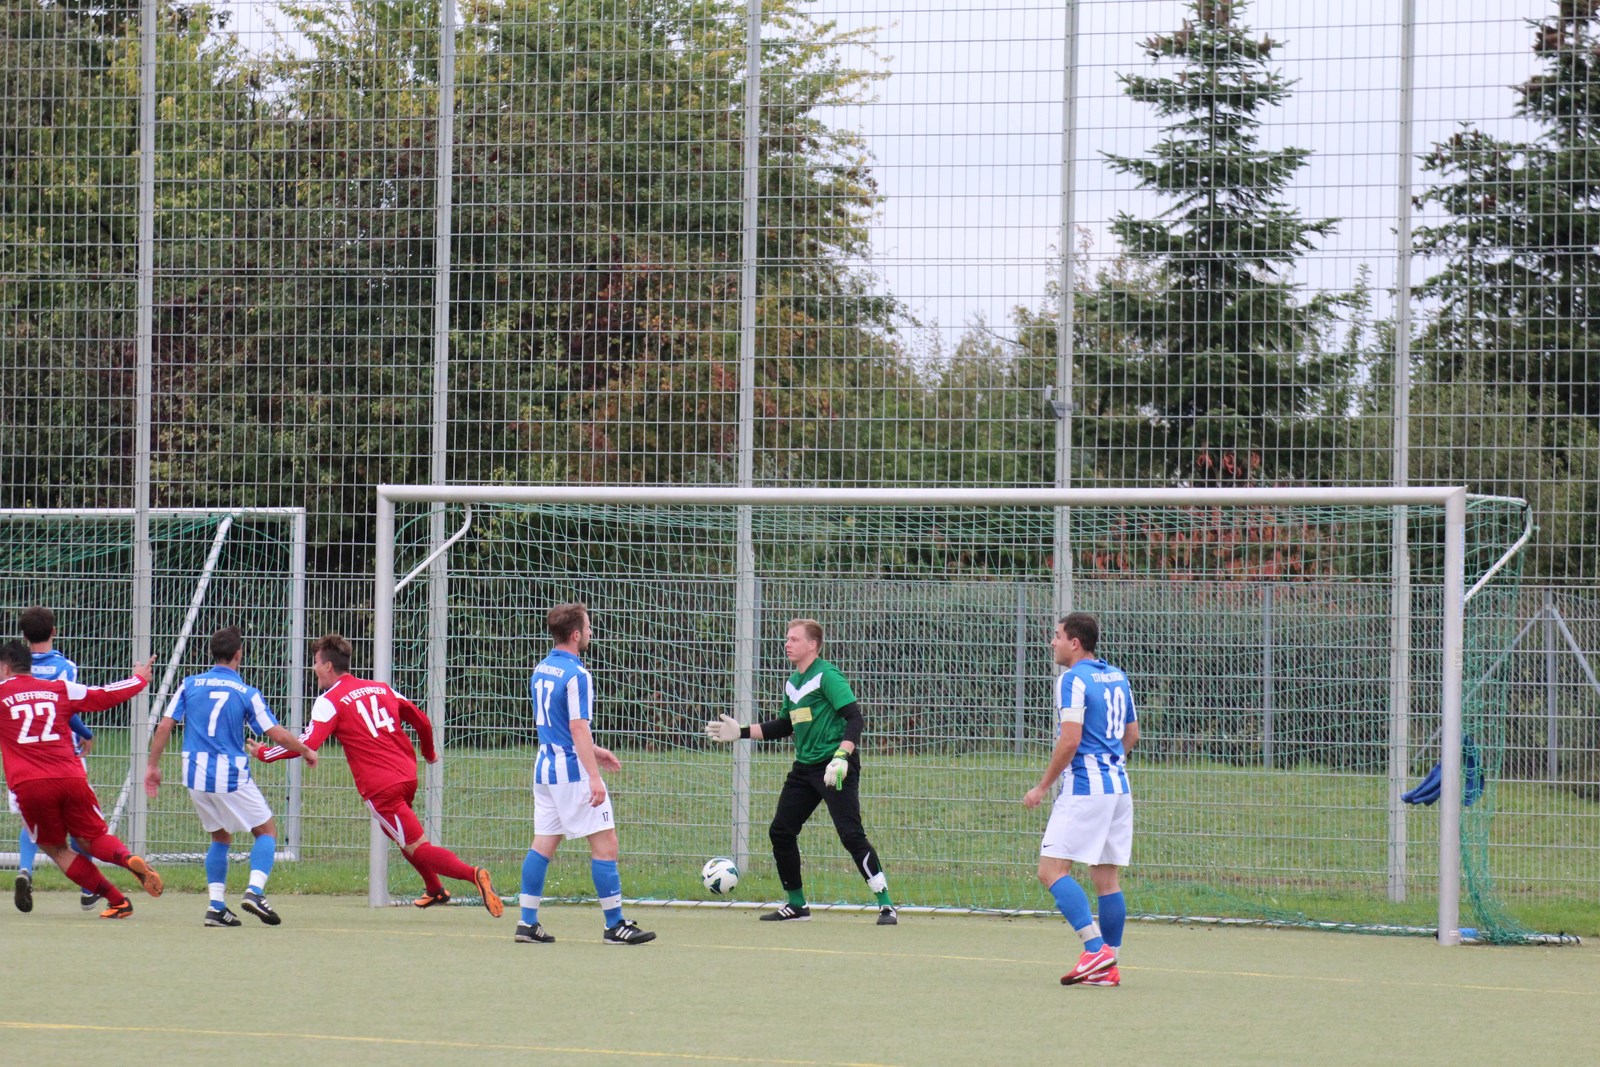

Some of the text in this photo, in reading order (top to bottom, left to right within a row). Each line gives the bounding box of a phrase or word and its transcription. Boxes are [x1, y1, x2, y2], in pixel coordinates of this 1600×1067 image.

[2, 690, 59, 708] TV OEFFINGEN
[194, 677, 248, 694] TSV MÜNCHINGEN
[339, 686, 387, 706] TV OEFFINGEN
[534, 678, 555, 727] 17
[10, 701, 60, 744] 22
[208, 691, 230, 737] 7
[355, 694, 396, 739] 14
[1104, 686, 1126, 740] 10
[602, 811, 609, 822] 17
